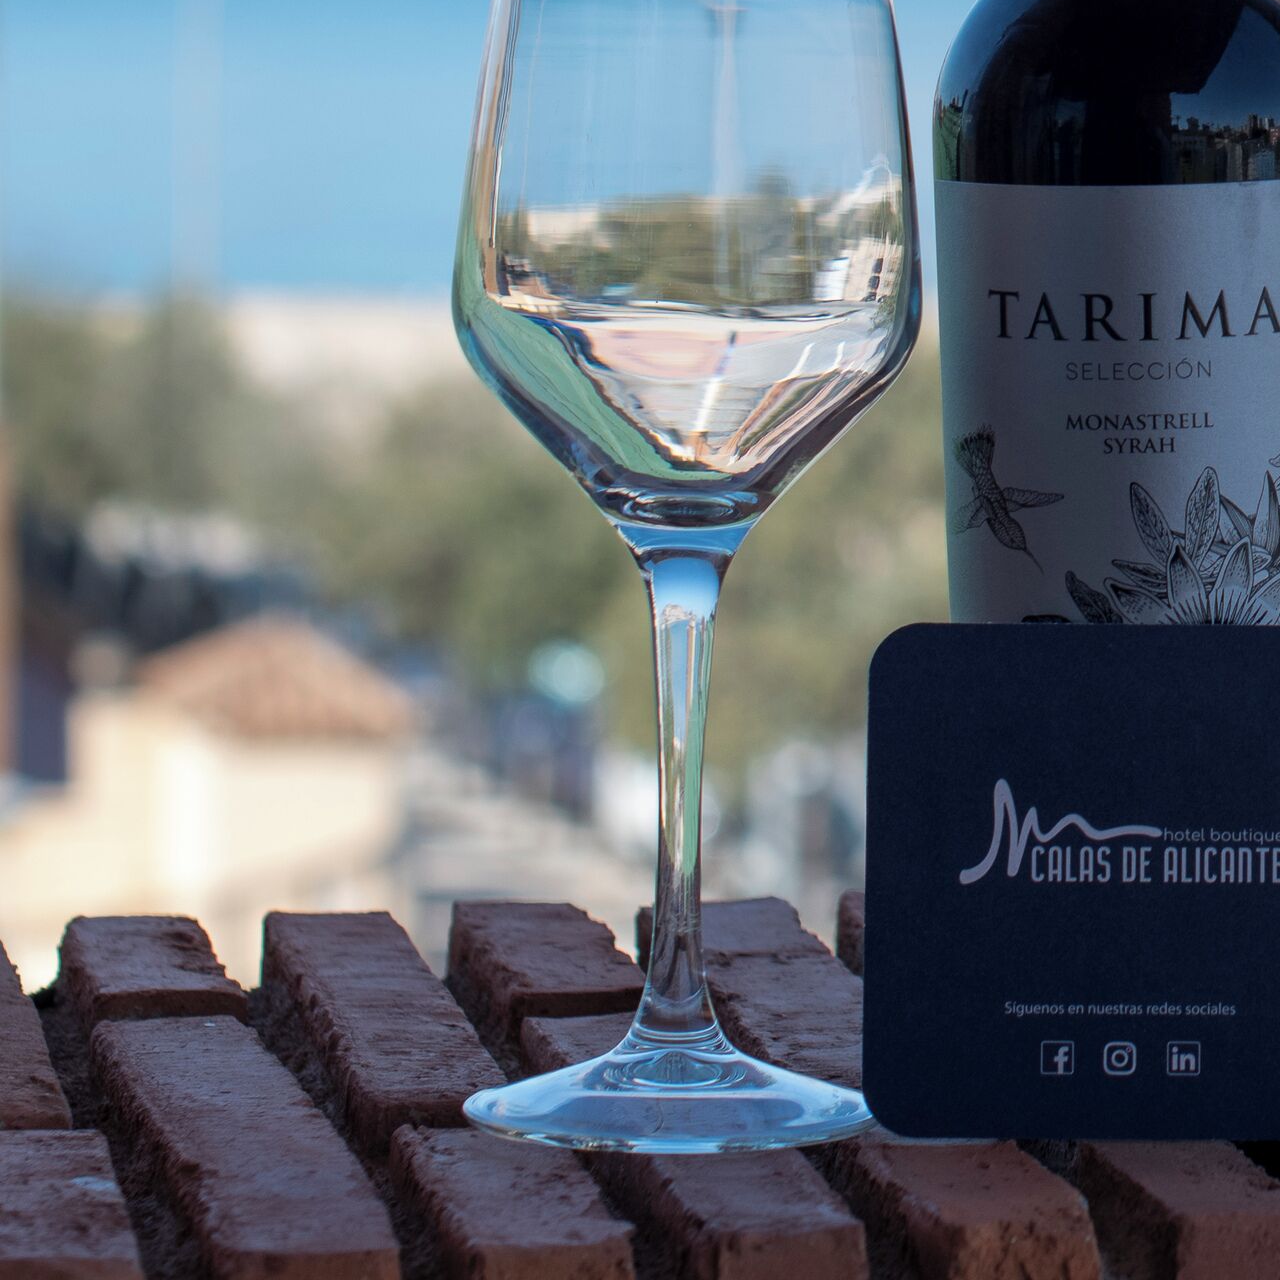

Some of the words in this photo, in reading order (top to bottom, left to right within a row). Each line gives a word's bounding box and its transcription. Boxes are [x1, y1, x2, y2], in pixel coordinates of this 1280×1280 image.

[1065, 357, 1212, 381] SELECCIÓN
[1065, 412, 1214, 432] MONASTRELL
[1103, 437, 1176, 455] SYRAH
[1163, 827, 1205, 842] hotel
[1030, 845, 1111, 883] CALAS
[1122, 846, 1152, 883] DE
[1004, 1001, 1065, 1017] Síguenos
[1068, 1005, 1084, 1014] en
[1088, 1003, 1143, 1015] nuestras
[1146, 1002, 1182, 1015] redes
[1185, 1002, 1237, 1016] sociales
